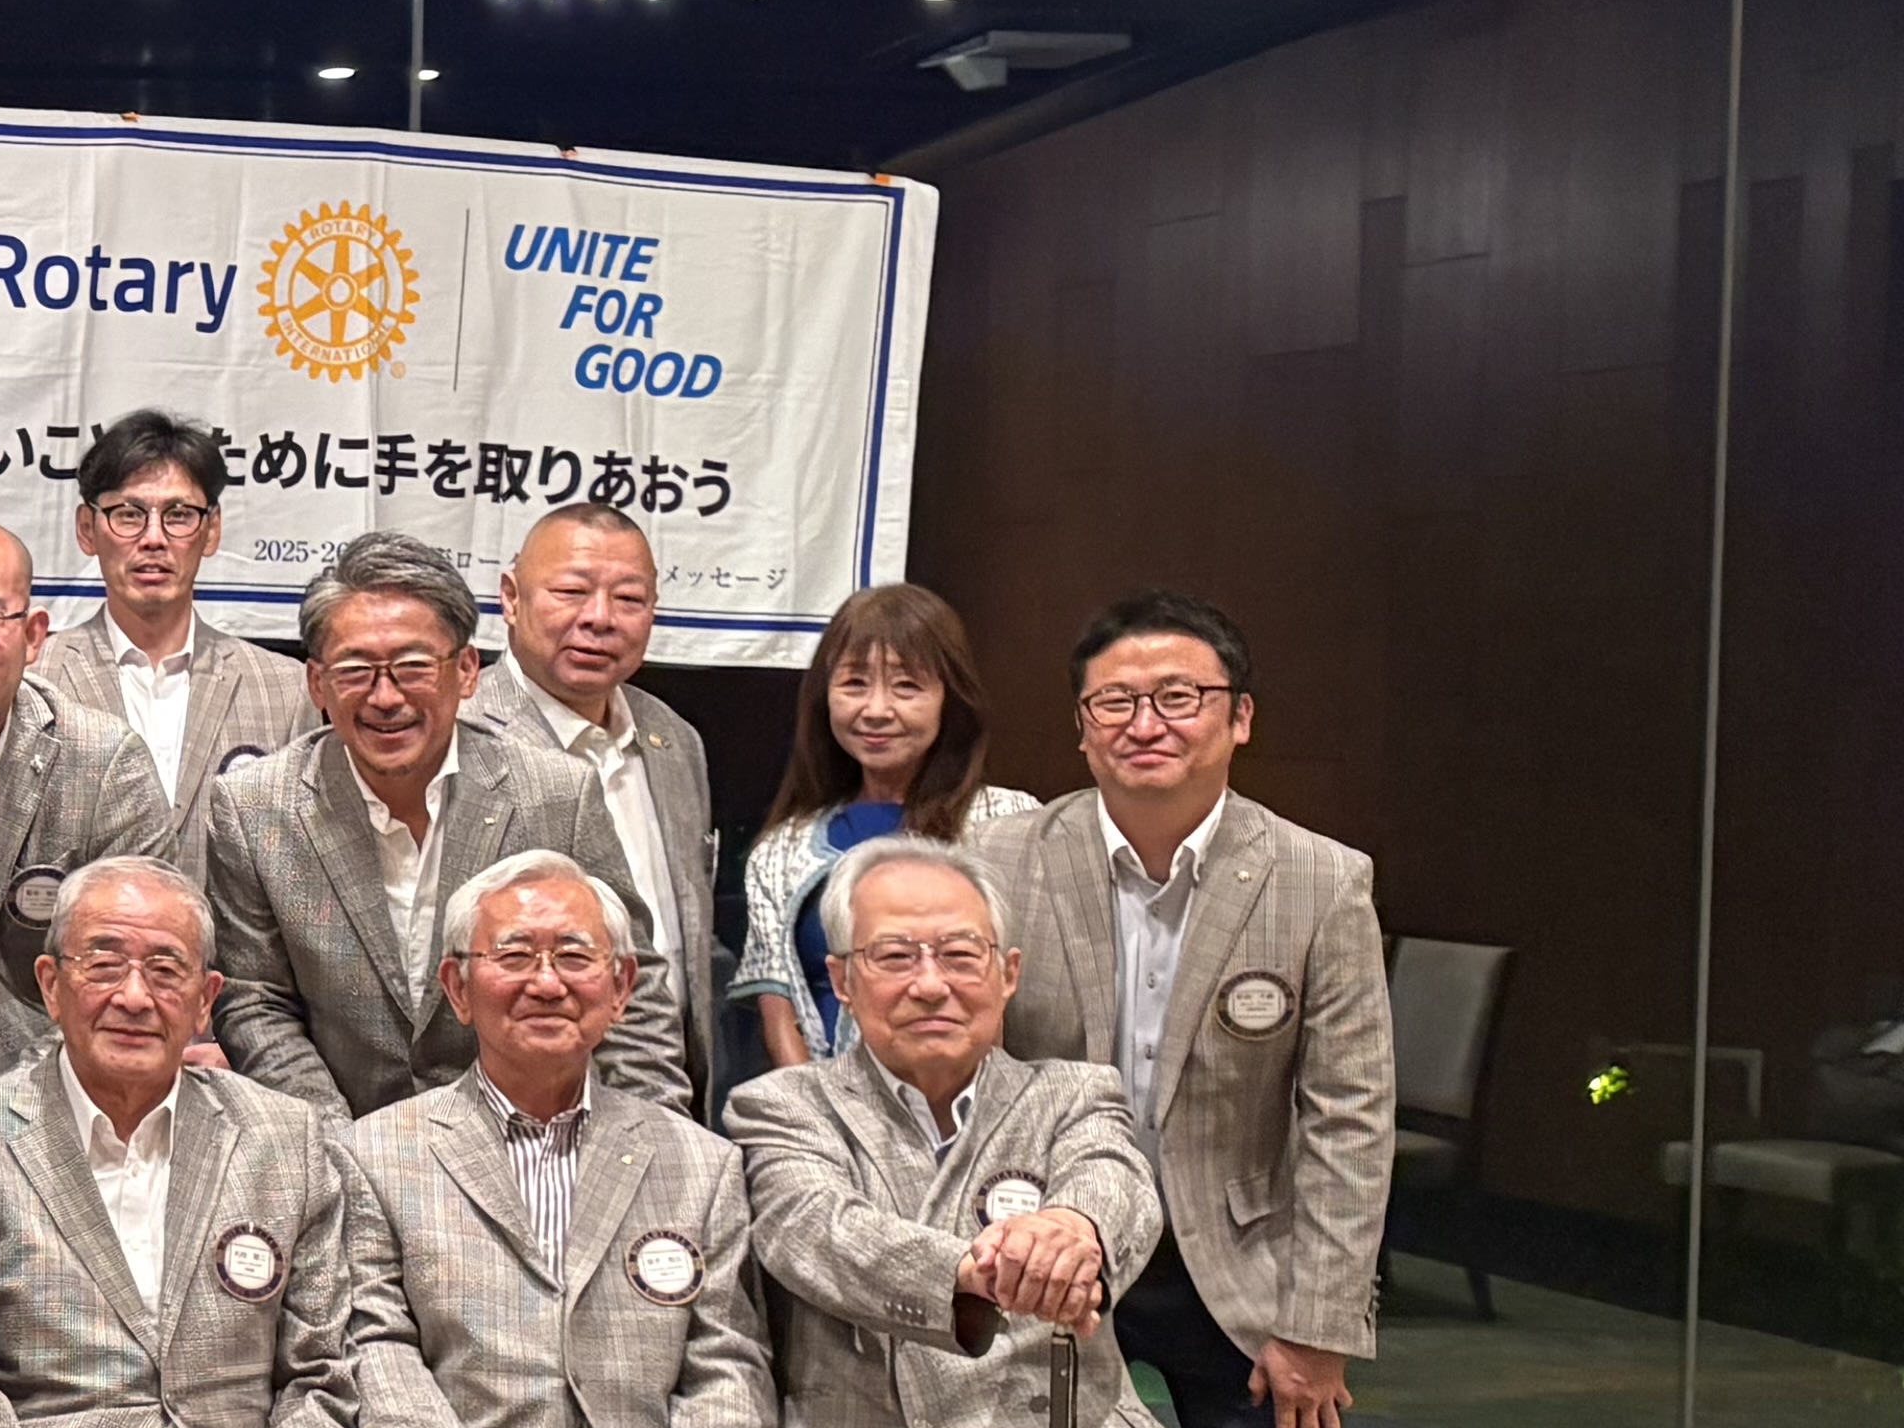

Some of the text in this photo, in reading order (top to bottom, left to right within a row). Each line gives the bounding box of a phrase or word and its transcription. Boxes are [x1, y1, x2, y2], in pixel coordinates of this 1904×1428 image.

[309, 221, 377, 240] ROTARY
[504, 224, 660, 282] UNITE
[559, 285, 663, 338] FOR
[280, 318, 393, 361] INTERNATIONAL
[575, 344, 722, 398] GOOD
[663, 566, 788, 589] メッセージ
